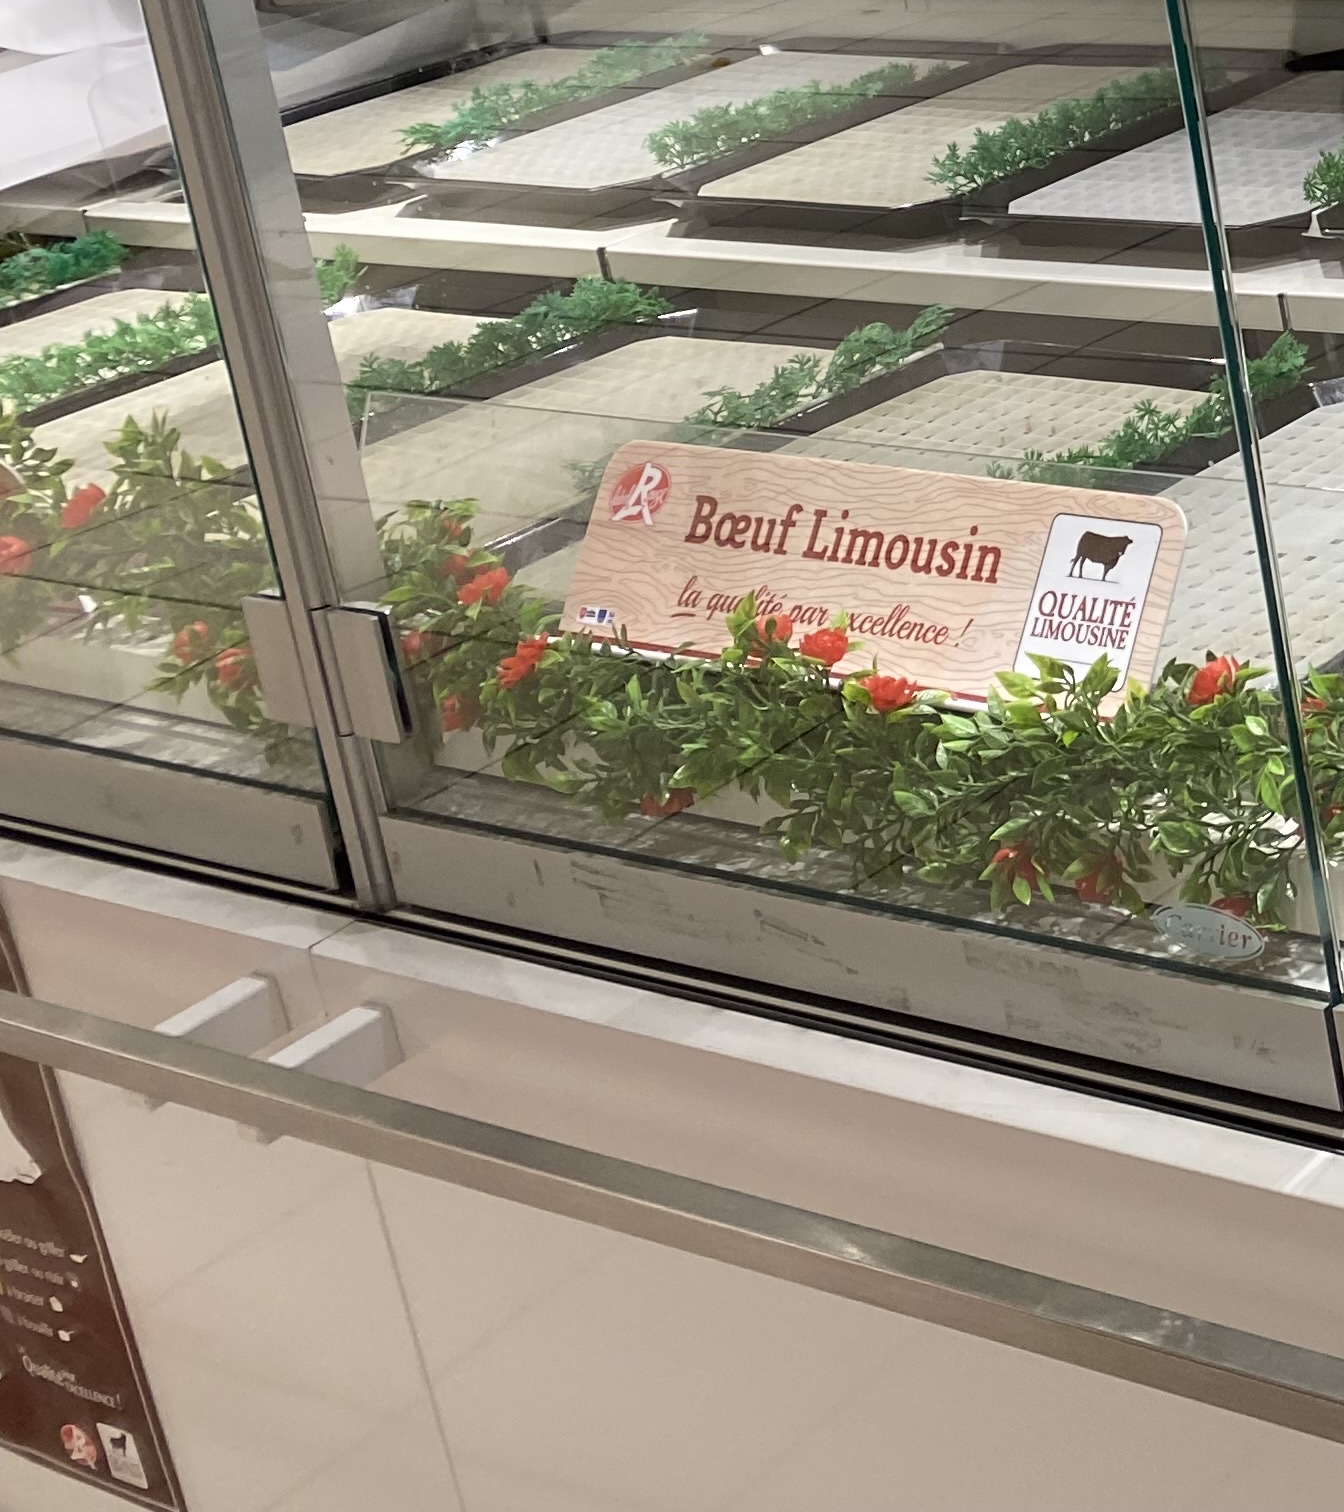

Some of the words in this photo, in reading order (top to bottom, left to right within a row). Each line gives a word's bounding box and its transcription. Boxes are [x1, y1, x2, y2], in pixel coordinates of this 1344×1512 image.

[684, 495, 803, 555] Bœuf
[802, 509, 1003, 584] Limousin
[839, 604, 949, 646] xcellence
[1038, 590, 1138, 629] QUALITÉ
[1029, 616, 1130, 651] LIMOUSINE
